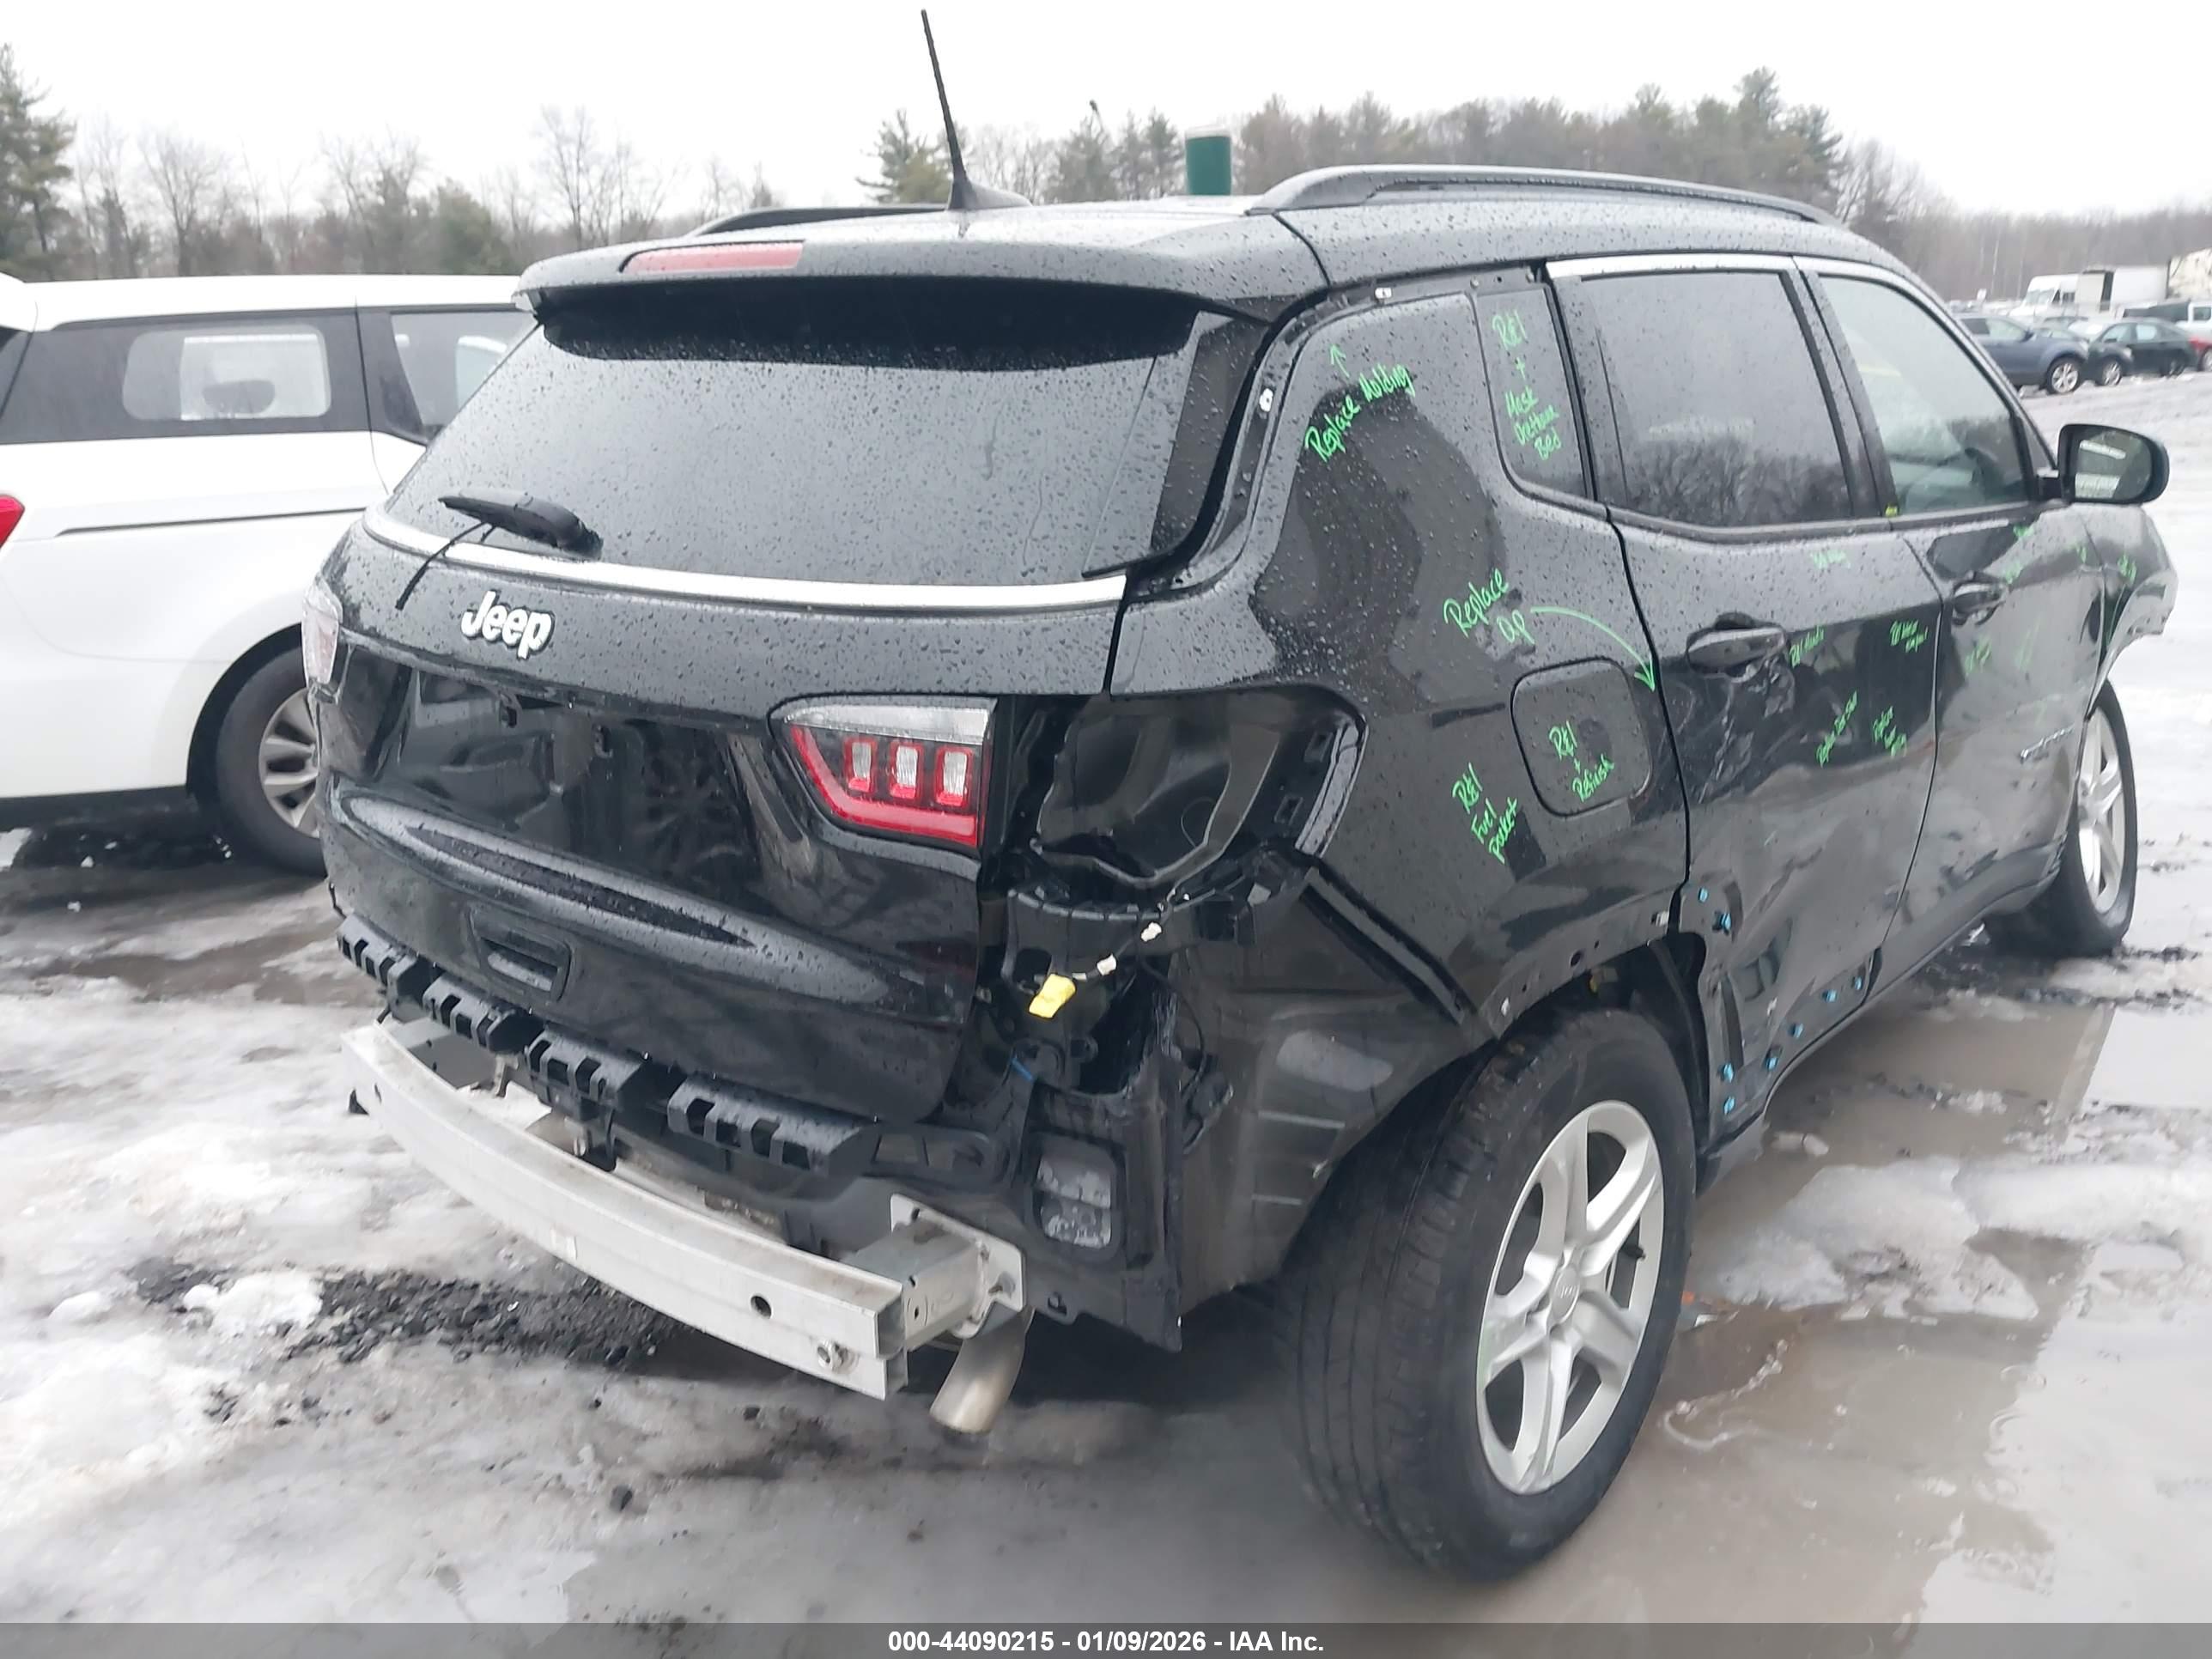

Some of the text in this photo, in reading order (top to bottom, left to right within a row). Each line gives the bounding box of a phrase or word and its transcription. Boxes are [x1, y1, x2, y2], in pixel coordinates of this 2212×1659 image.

[1304, 394, 1362, 462] Replace
[461, 590, 553, 659] Jeep
[1443, 568, 1509, 638] Replace
